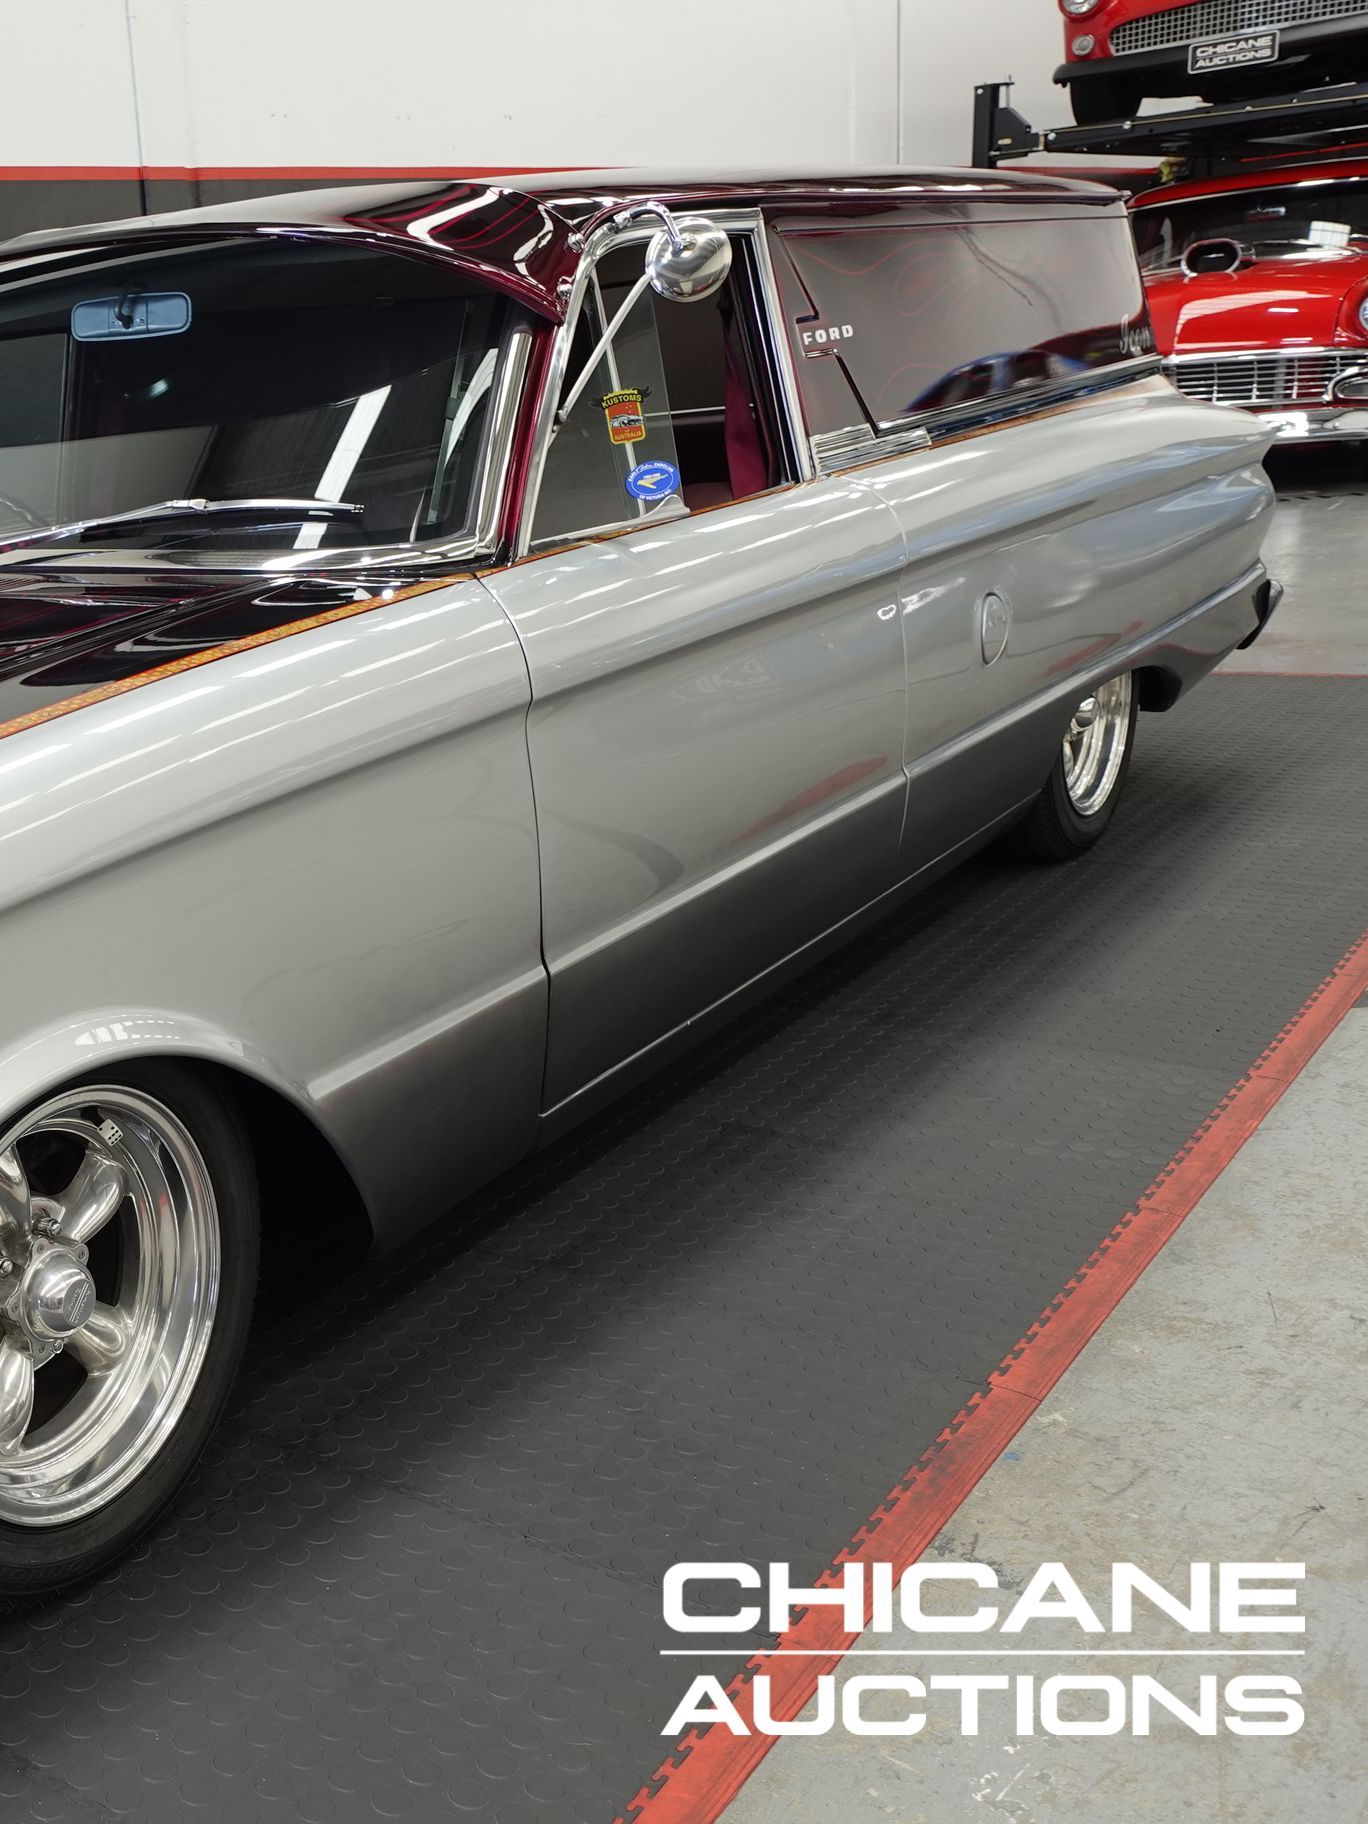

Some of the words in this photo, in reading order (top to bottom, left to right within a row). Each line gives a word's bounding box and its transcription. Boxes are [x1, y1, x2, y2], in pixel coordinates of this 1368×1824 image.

[1195, 36, 1273, 57] CHICANE
[1193, 48, 1273, 69] AUCTIONS
[802, 324, 854, 346] FORD
[601, 394, 642, 409] KUSTOMS
